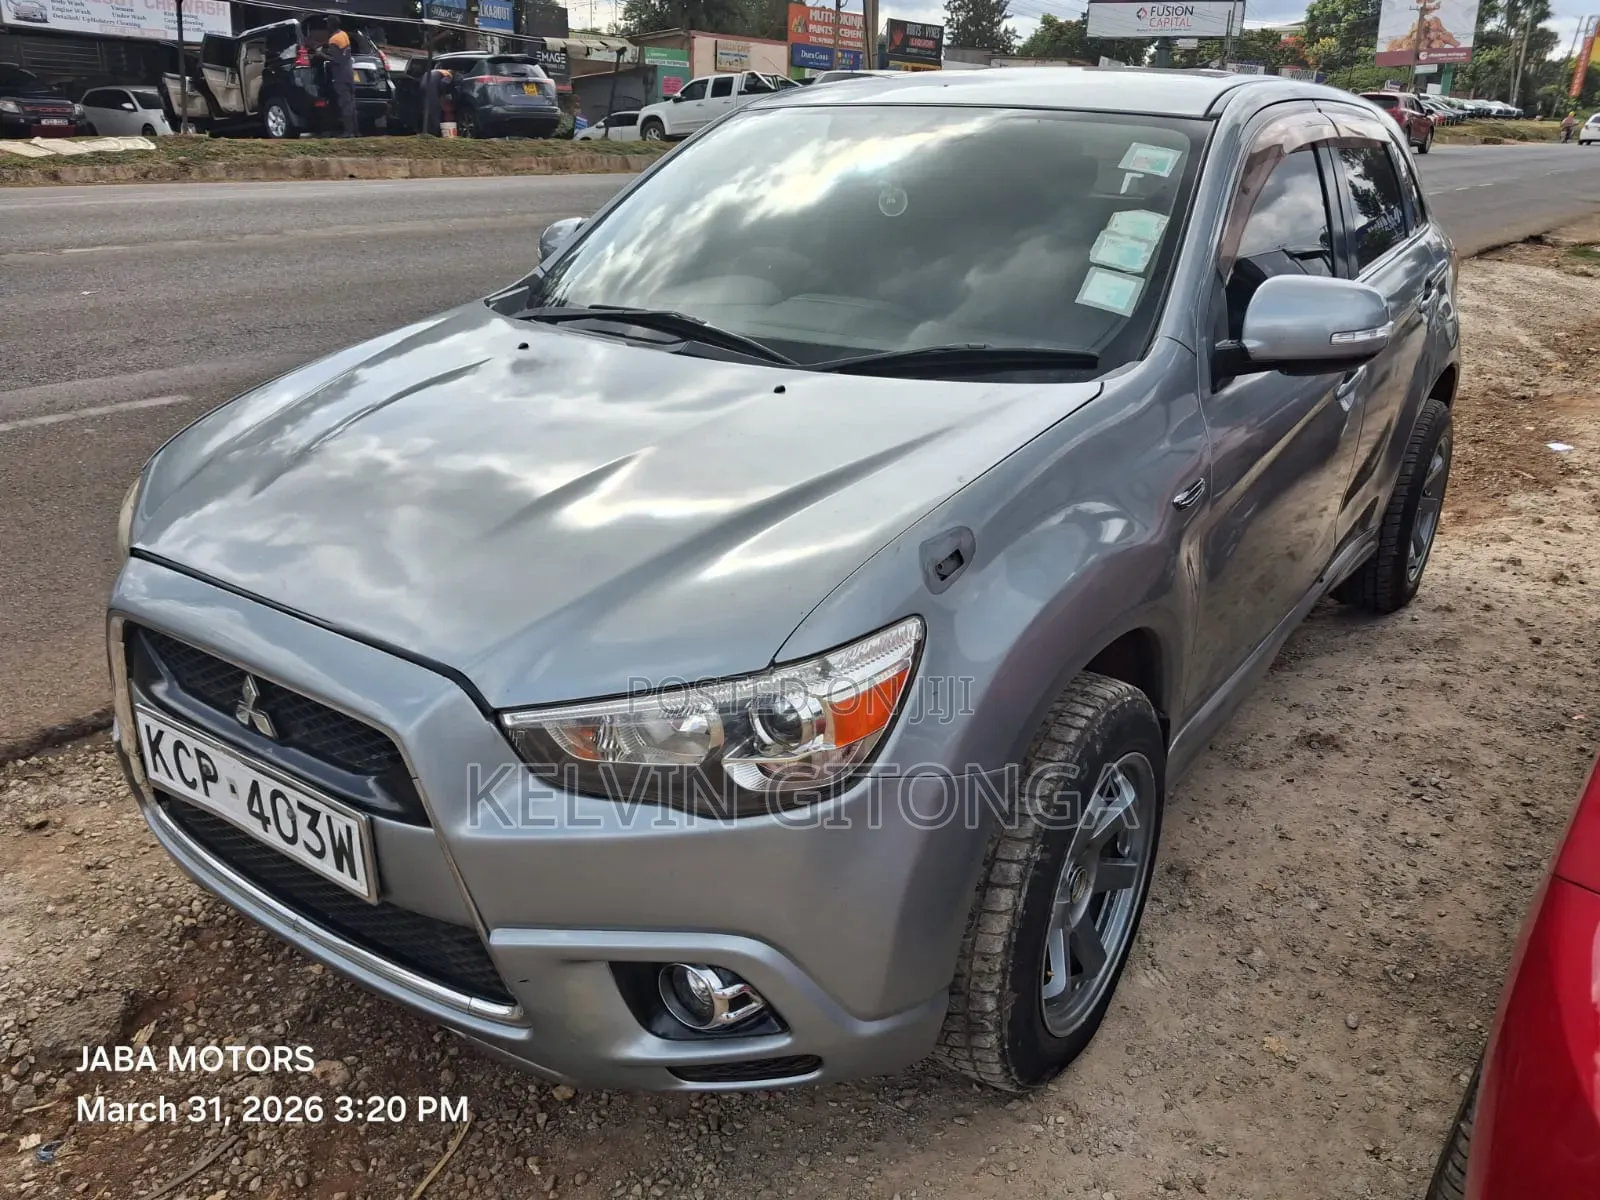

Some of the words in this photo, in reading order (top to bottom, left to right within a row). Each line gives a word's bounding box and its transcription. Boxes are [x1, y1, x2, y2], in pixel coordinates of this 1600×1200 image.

[480, 3, 510, 20] LKABOUT
[1150, 5, 1195, 17] FUSION
[1149, 17, 1193, 28] CAPITAL
[145, 724, 219, 798] KCP
[246, 779, 358, 881] 403W
